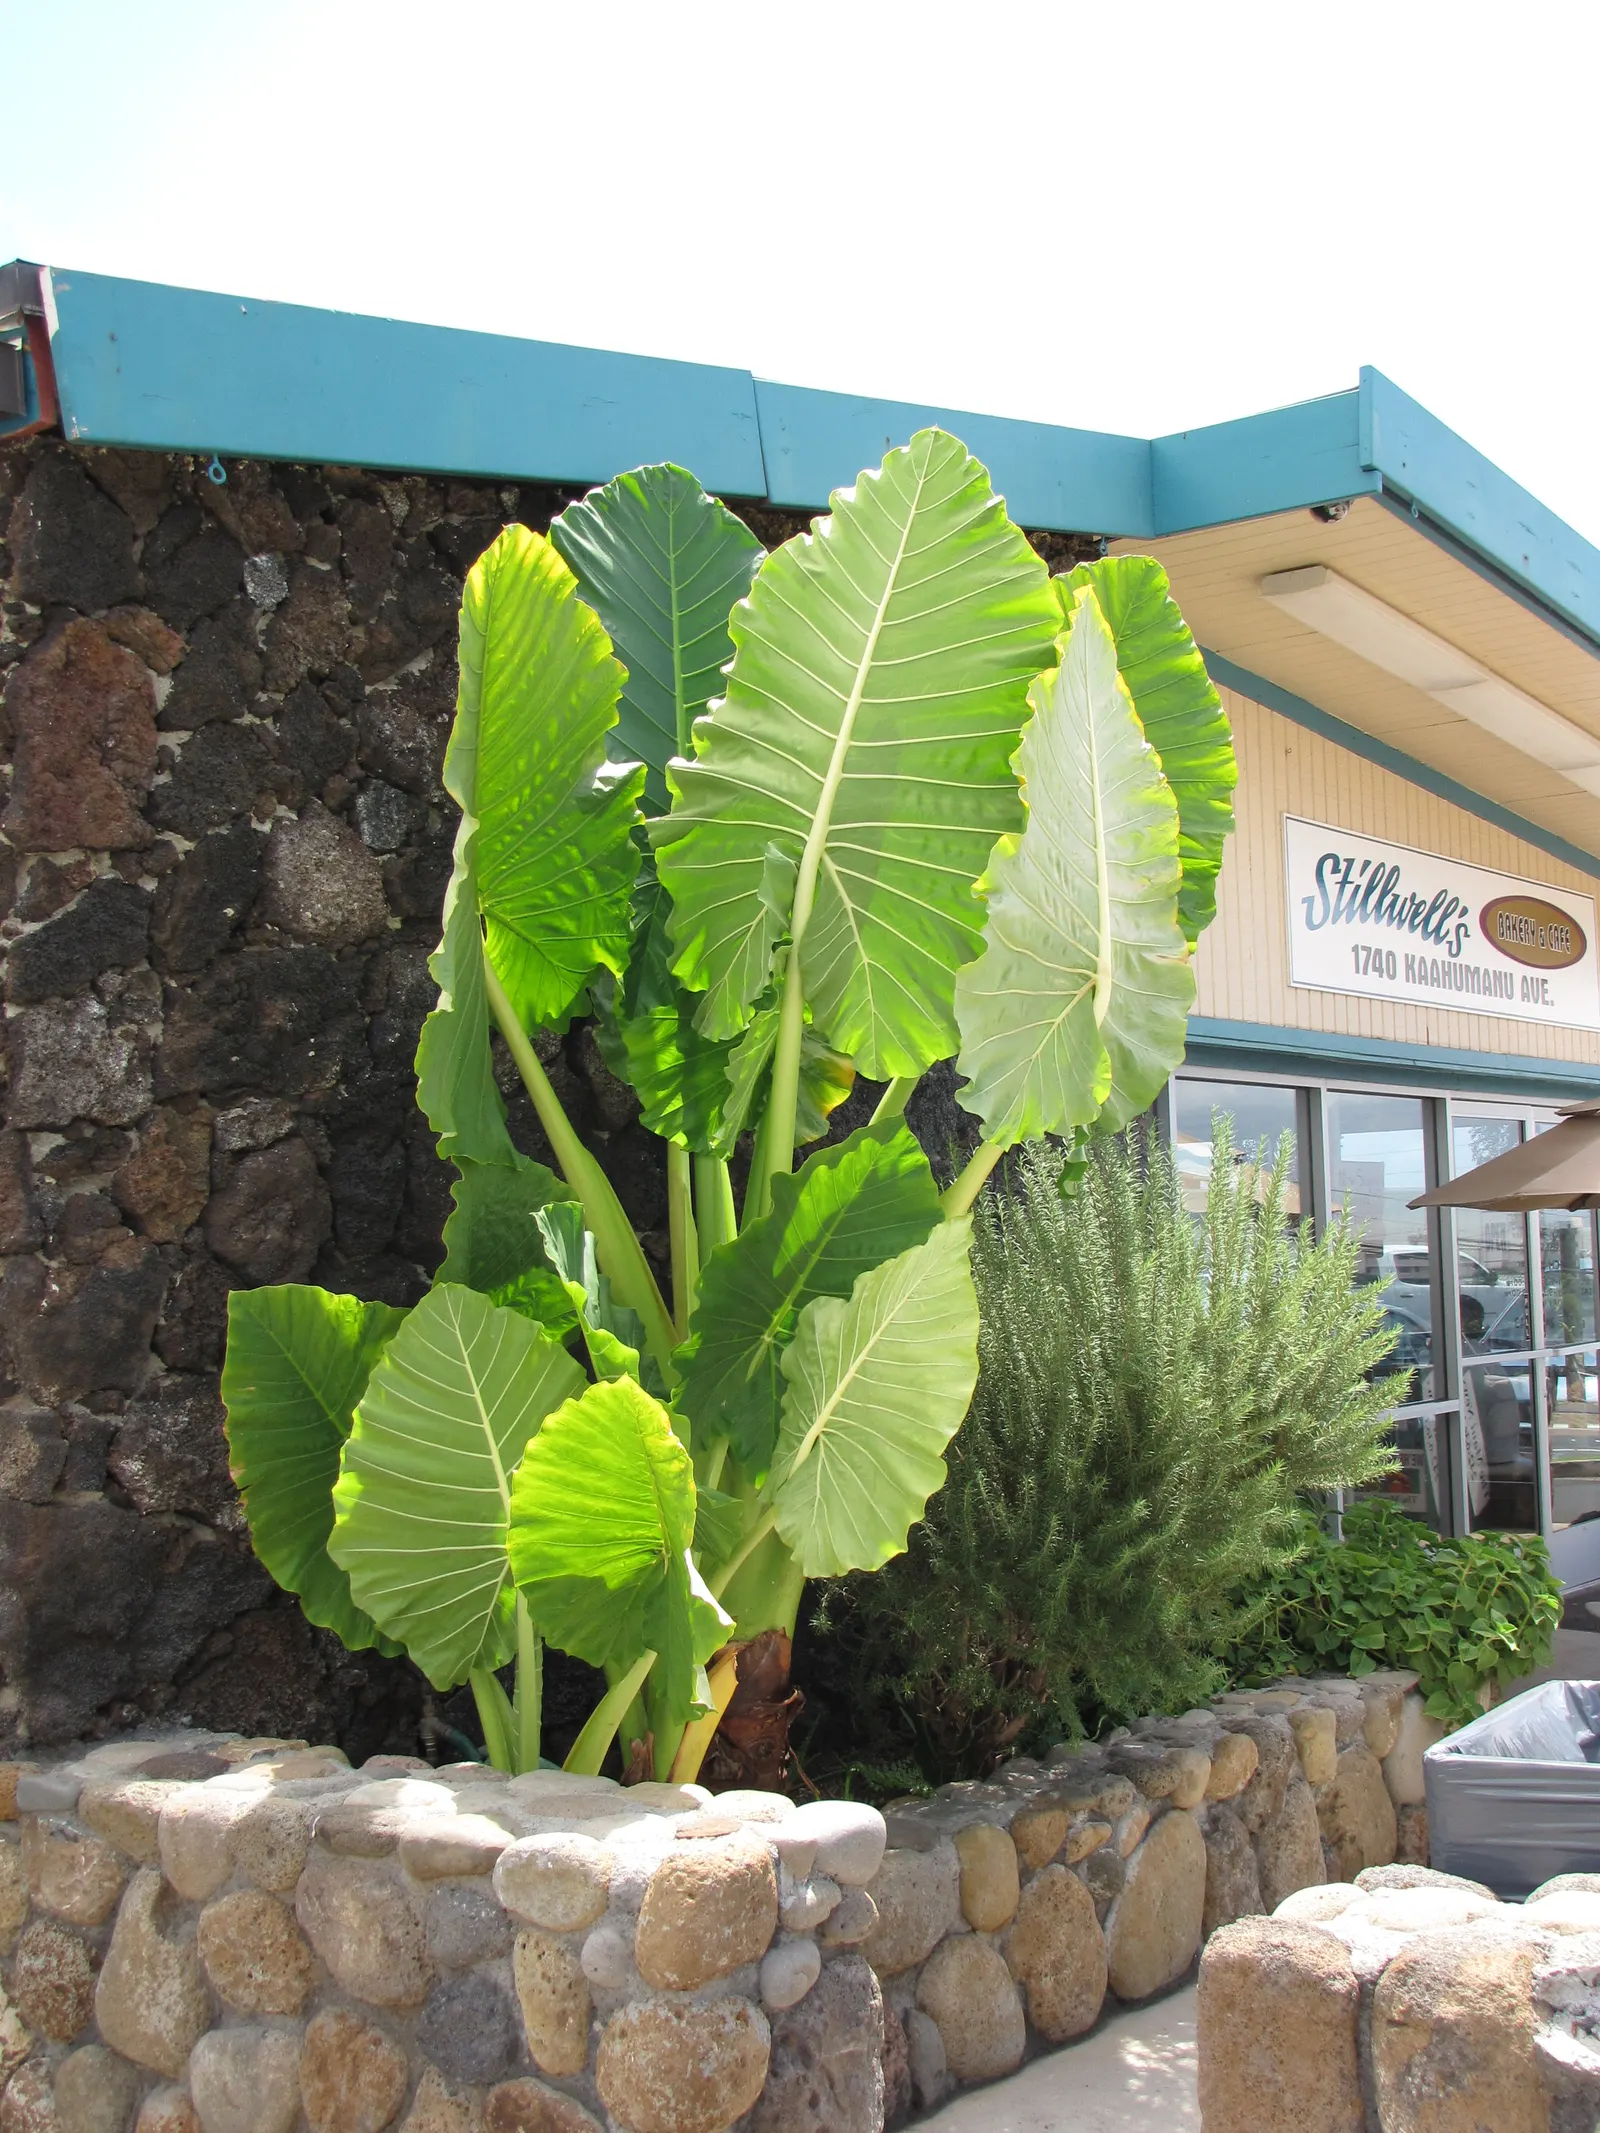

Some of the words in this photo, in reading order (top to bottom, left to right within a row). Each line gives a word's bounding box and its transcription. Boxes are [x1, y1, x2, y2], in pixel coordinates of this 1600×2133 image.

[1301, 853, 1470, 958] Stillwell's
[1497, 910, 1536, 947] BAKERY
[1539, 926, 1546, 947] &
[1548, 922, 1571, 955] CAFE
[1351, 944, 1396, 980] 1740
[1405, 953, 1514, 1000] KAAHUMANU
[1521, 975, 1554, 1006] AVE.
